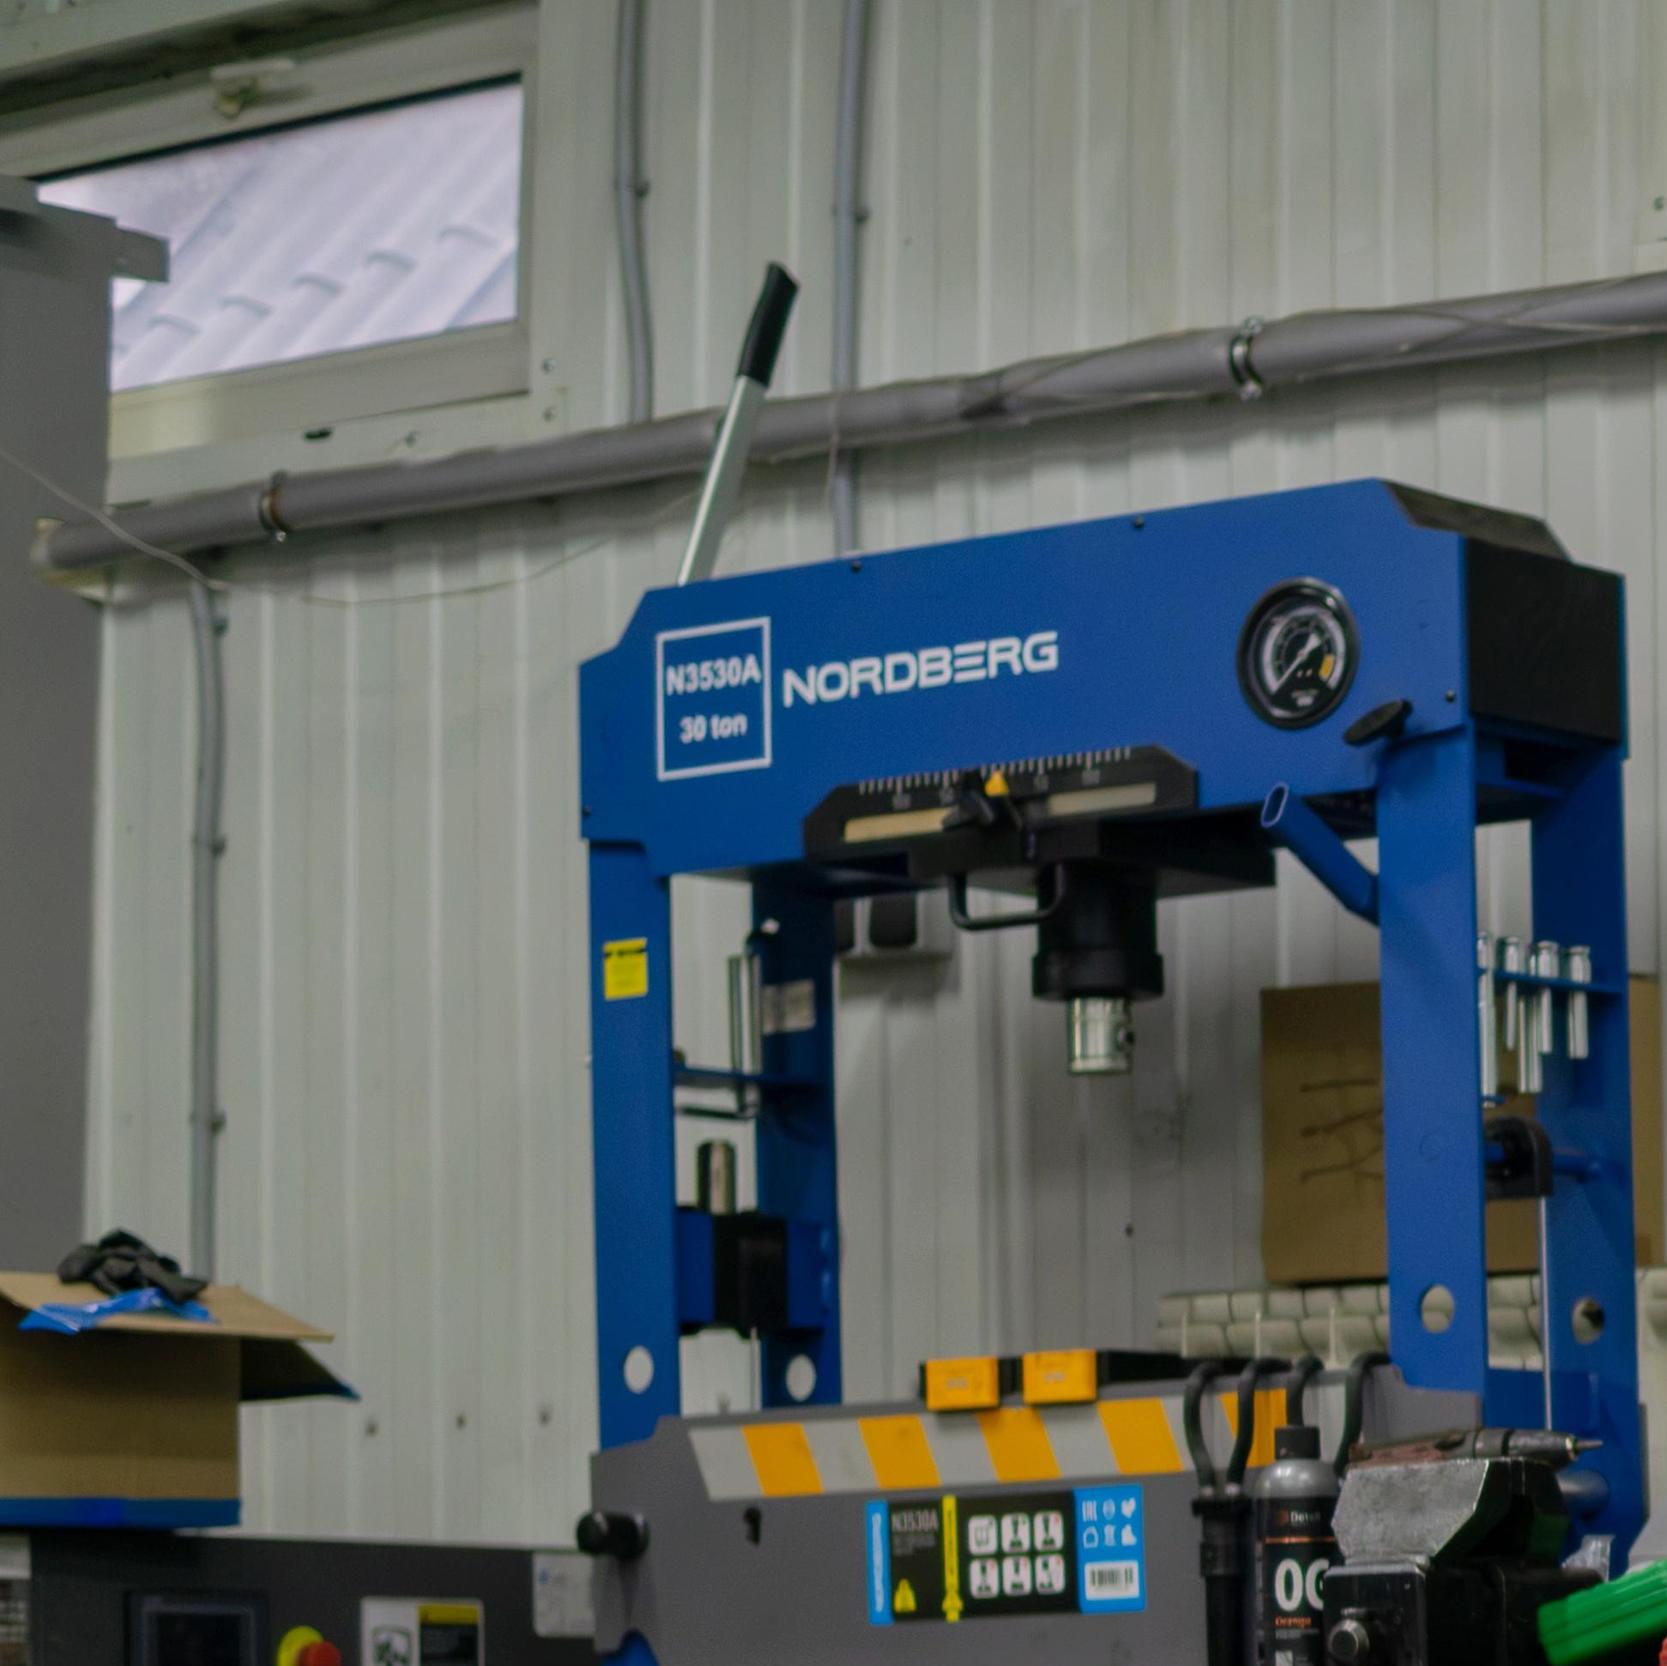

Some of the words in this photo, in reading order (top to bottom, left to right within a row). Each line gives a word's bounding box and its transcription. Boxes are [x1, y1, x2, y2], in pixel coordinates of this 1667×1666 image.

[666, 654, 761, 696] N3530A
[783, 631, 1058, 708] NORDBERG
[680, 716, 706, 743] 30
[711, 714, 747, 740] ton
